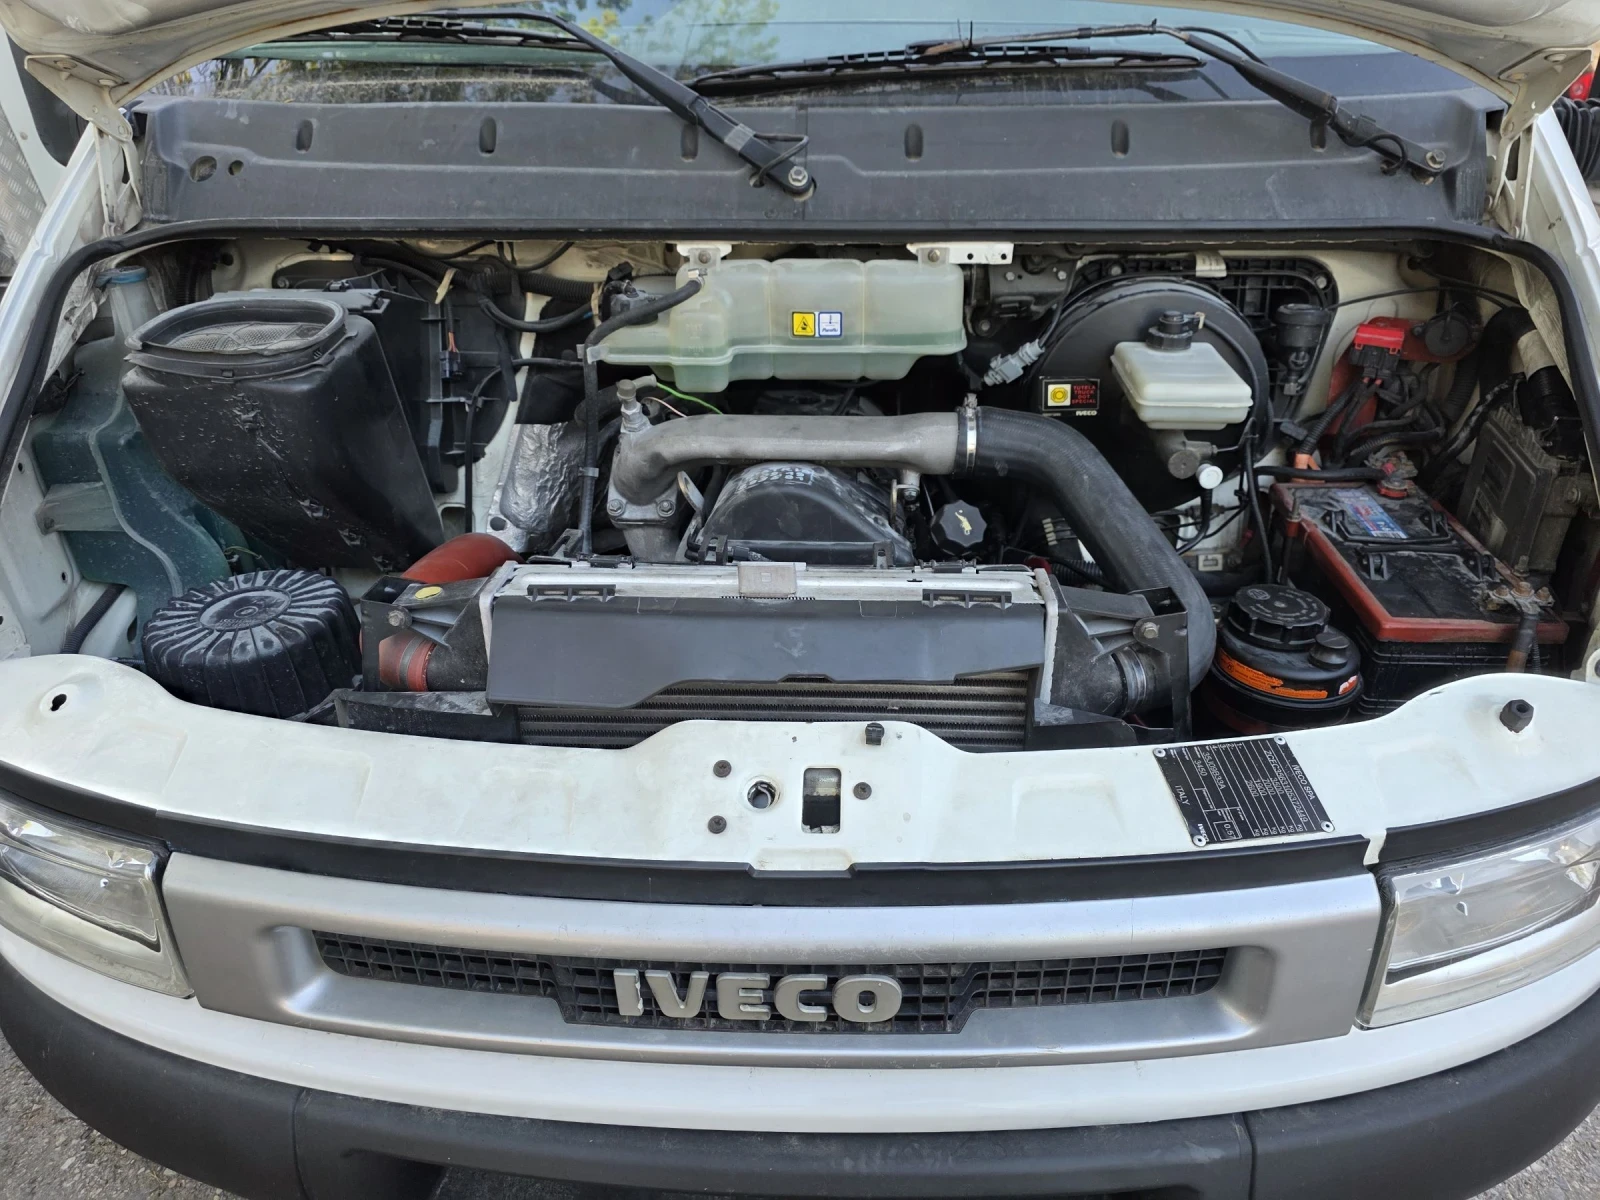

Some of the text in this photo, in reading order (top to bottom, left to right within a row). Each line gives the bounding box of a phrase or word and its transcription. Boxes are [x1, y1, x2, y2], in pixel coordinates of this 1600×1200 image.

[1193, 759, 1208, 776] 3450
[1270, 777, 1284, 794] 3500
[1291, 764, 1316, 799] IVECO SPA
[1174, 785, 1190, 805] ITALY
[613, 968, 902, 1023] IVECO
